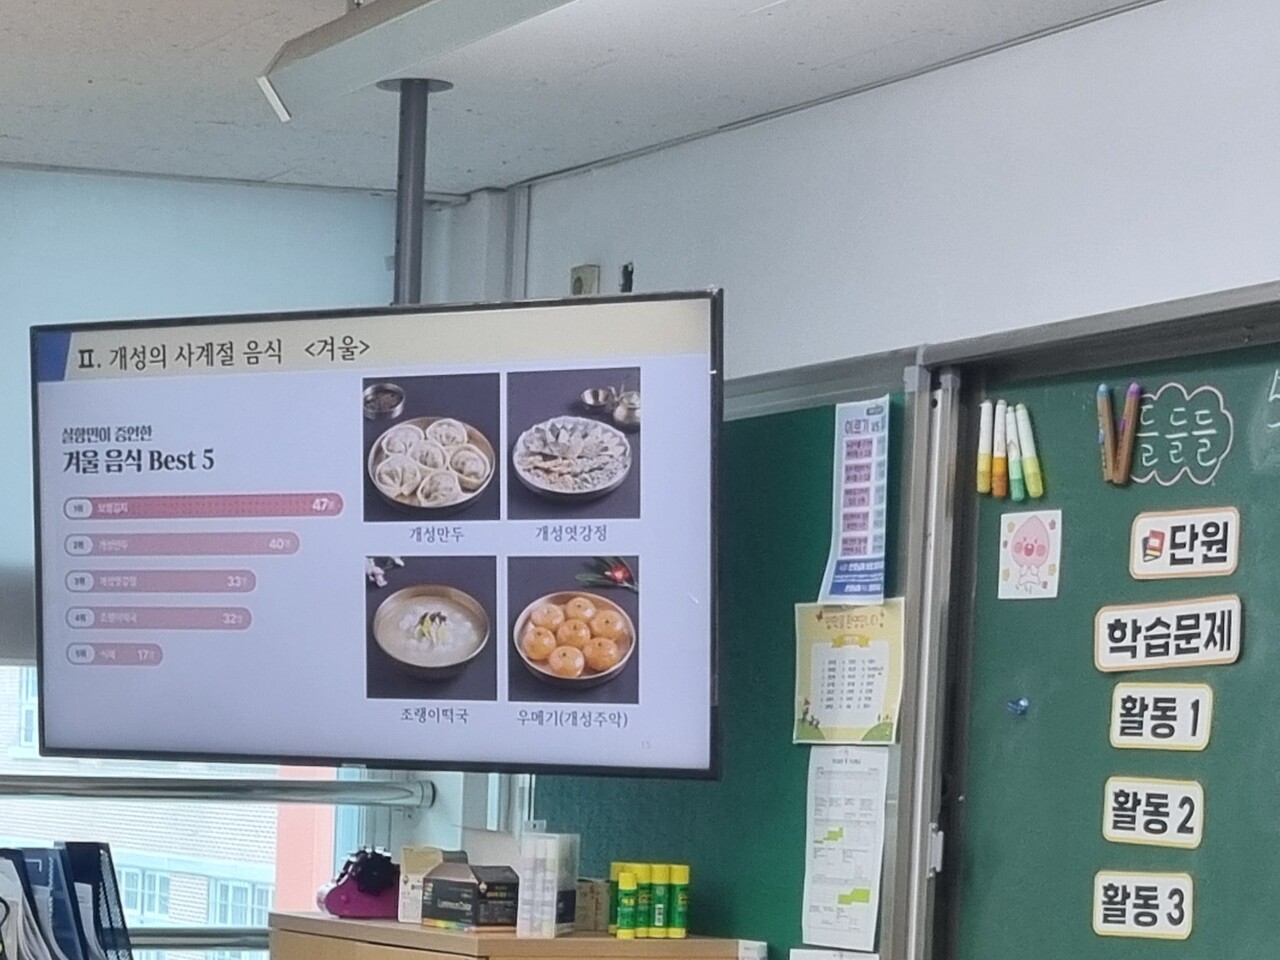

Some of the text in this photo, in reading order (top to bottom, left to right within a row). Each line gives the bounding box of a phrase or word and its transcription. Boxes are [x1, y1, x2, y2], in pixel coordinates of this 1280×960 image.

[109, 343, 167, 372] 개성의
[174, 340, 235, 368] 사계절
[242, 338, 283, 366] 음식
[304, 335, 370, 363] <겨울>
[62, 426, 111, 444] 실향민이
[63, 448, 215, 474] 겨울 음식 Best 5
[409, 526, 465, 543] 개성만두
[535, 525, 608, 542] 개성엿강정
[1169, 521, 1229, 566] 단원
[1107, 609, 1233, 659] 학습문제
[401, 707, 470, 725] 조랭이떡국
[516, 709, 629, 728] 우메기(개성주악)
[1119, 695, 1200, 739] 활동 1
[1112, 789, 1195, 835] 활동 2
[1102, 883, 1185, 927] 활동 3
